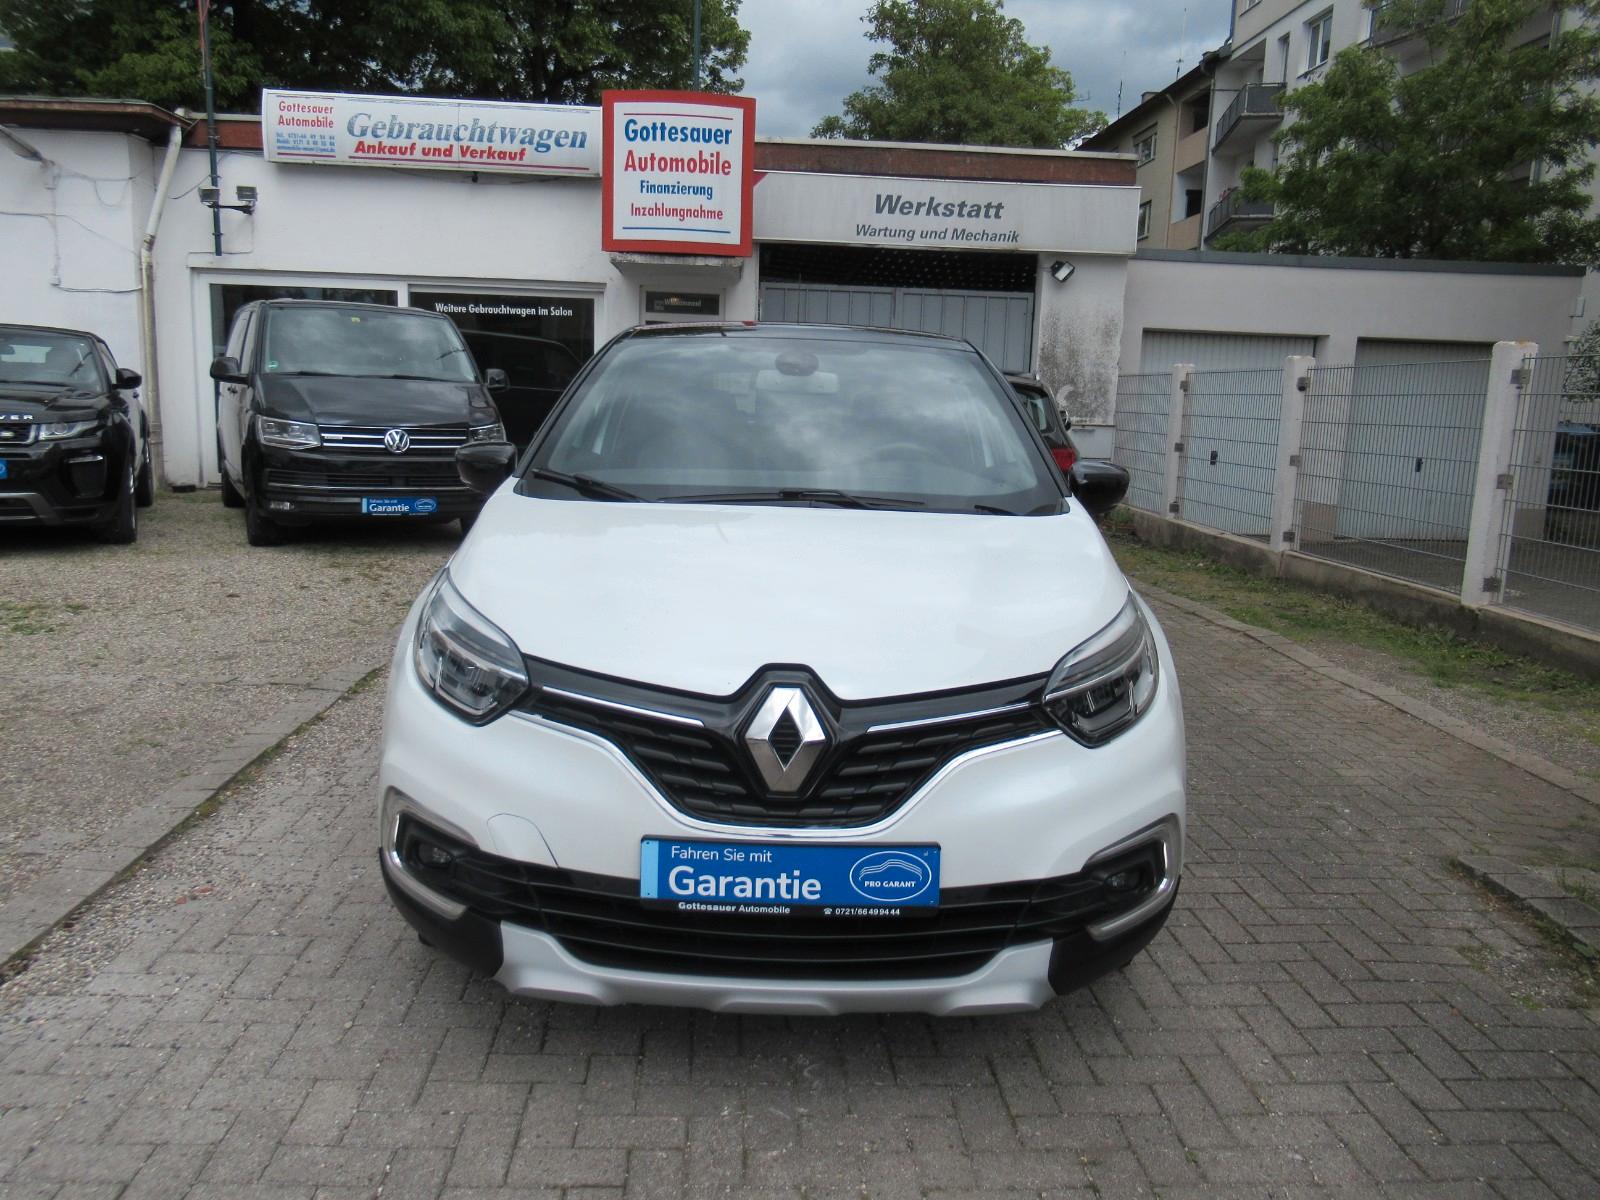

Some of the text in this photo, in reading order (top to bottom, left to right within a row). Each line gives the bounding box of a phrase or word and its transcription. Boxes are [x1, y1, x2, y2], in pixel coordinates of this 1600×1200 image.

[278, 101, 334, 114] Gottesauer
[278, 115, 334, 128] Automobile
[624, 118, 732, 145] Gottesauer
[346, 112, 588, 153] Gebrauchtwagen
[354, 141, 526, 161] Ankauf und Verkauf
[624, 150, 732, 176] Automobile
[640, 179, 713, 200] Finanzierung
[631, 202, 724, 222] Inzahlungnahme
[875, 194, 1004, 220] Werkstatt
[856, 224, 1019, 243] Wartung und Mechanik
[435, 302, 573, 317] Weitere Gebrauchtwagen im Salon
[369, 503, 410, 512] Garantie
[671, 845, 772, 863] Fahren Sie mit
[668, 865, 822, 900] Garantie
[678, 902, 790, 914] Gottesauer Automobile
